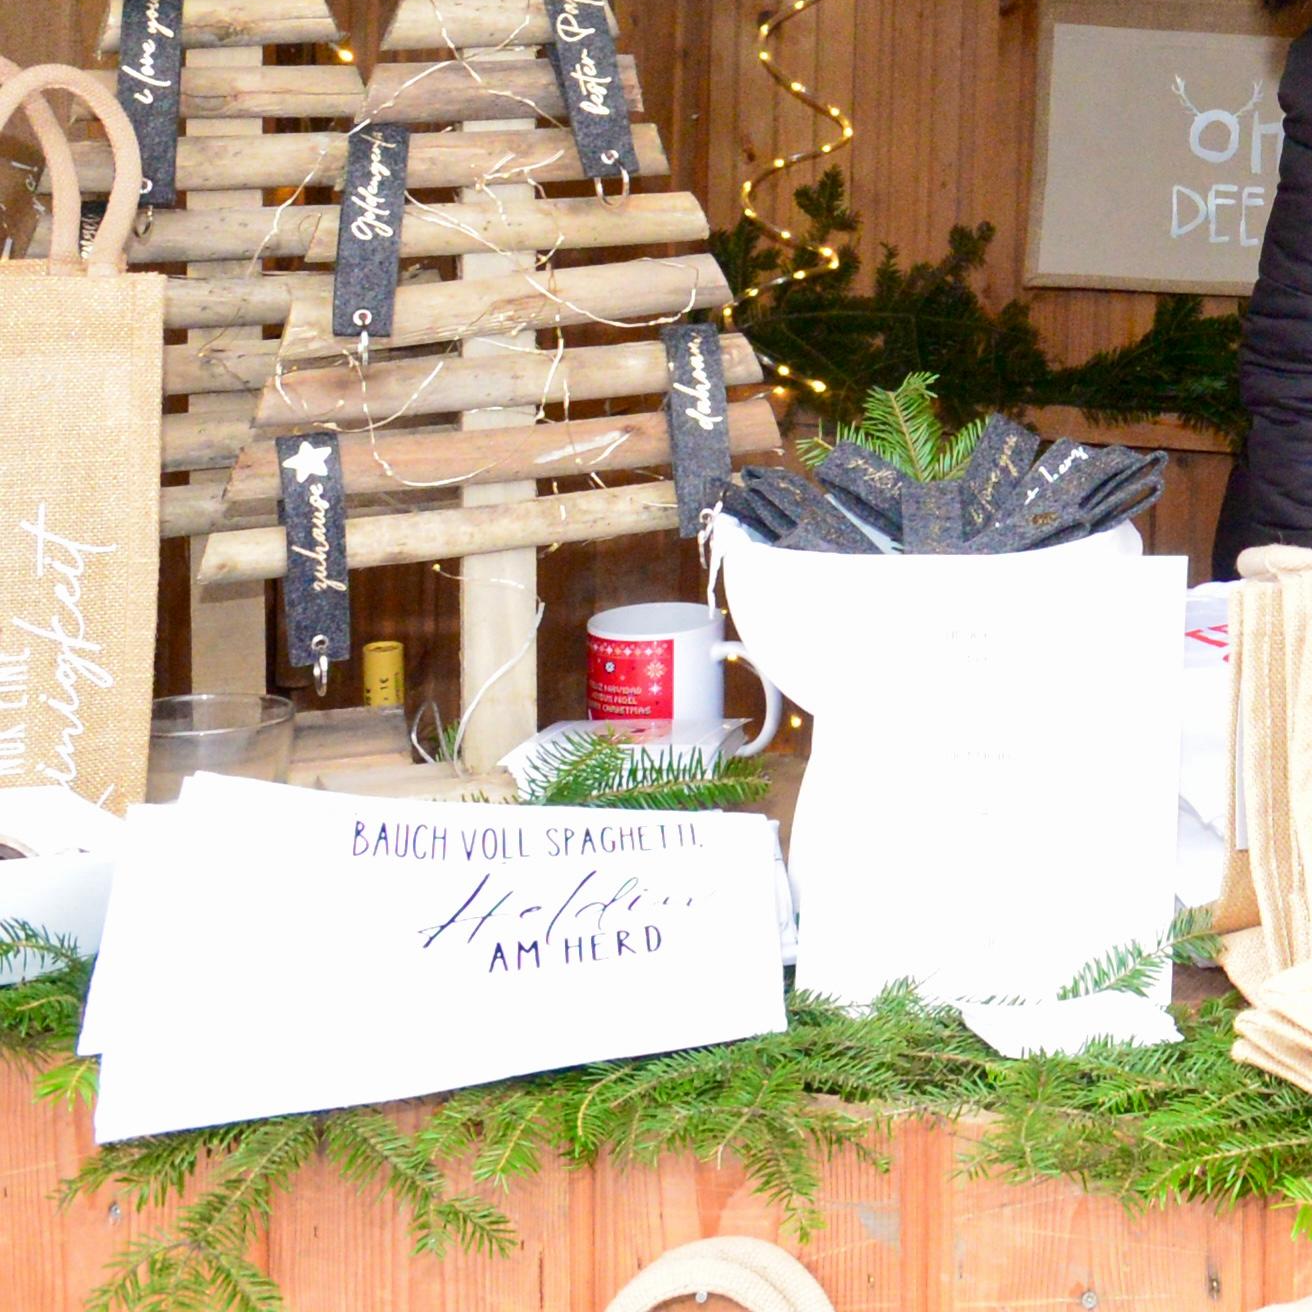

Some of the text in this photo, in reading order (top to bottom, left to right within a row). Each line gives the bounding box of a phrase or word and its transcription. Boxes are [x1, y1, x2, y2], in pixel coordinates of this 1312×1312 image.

[1171, 184, 1265, 247] DEE
[351, 819, 448, 861] BAUCH
[459, 826, 531, 862] VOLL
[488, 924, 663, 974] AM HERD
